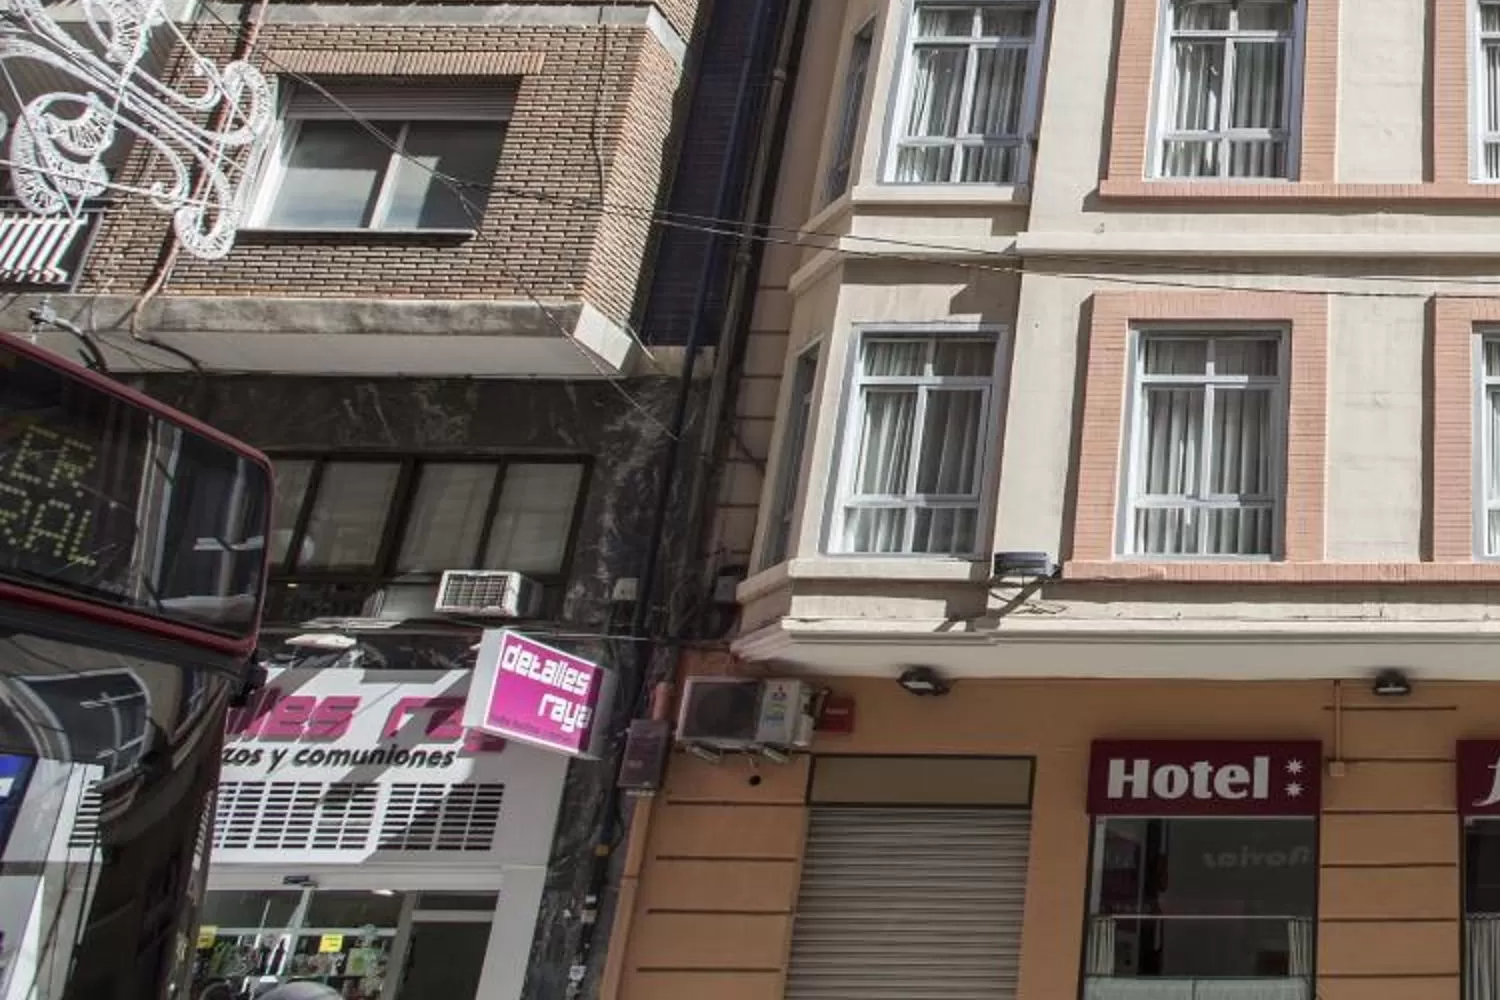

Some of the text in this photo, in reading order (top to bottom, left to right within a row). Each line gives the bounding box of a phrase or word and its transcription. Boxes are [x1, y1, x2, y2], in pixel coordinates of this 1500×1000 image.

[0, 424, 97, 498] ER
[502, 644, 591, 697] detalles
[538, 693, 592, 733] raya
[268, 748, 289, 775] y
[292, 744, 456, 769] comuniones
[1107, 756, 1270, 799] Hotel
